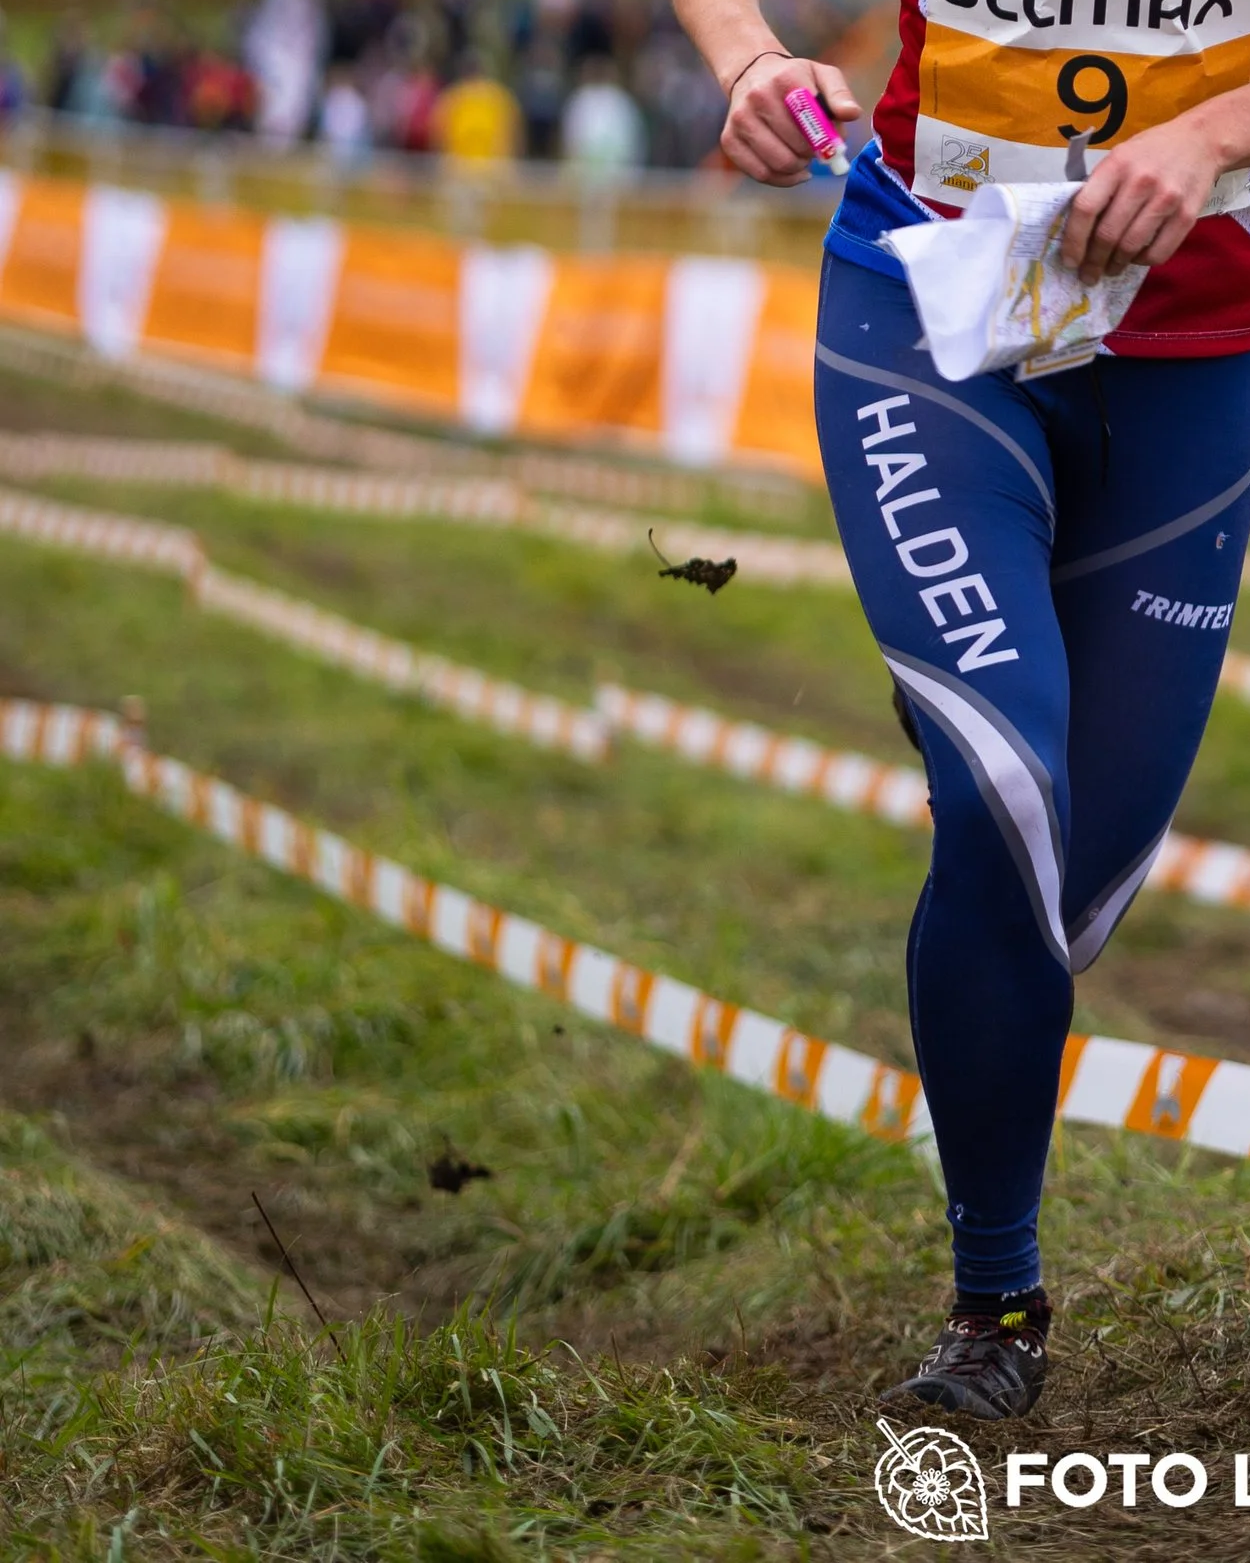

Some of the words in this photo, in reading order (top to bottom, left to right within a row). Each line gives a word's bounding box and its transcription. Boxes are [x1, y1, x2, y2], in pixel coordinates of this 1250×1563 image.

[1056, 54, 1129, 146] 9
[944, 139, 986, 172] 25
[857, 394, 1019, 673] HALDEN
[1130, 589, 1234, 630] TRIMTEX
